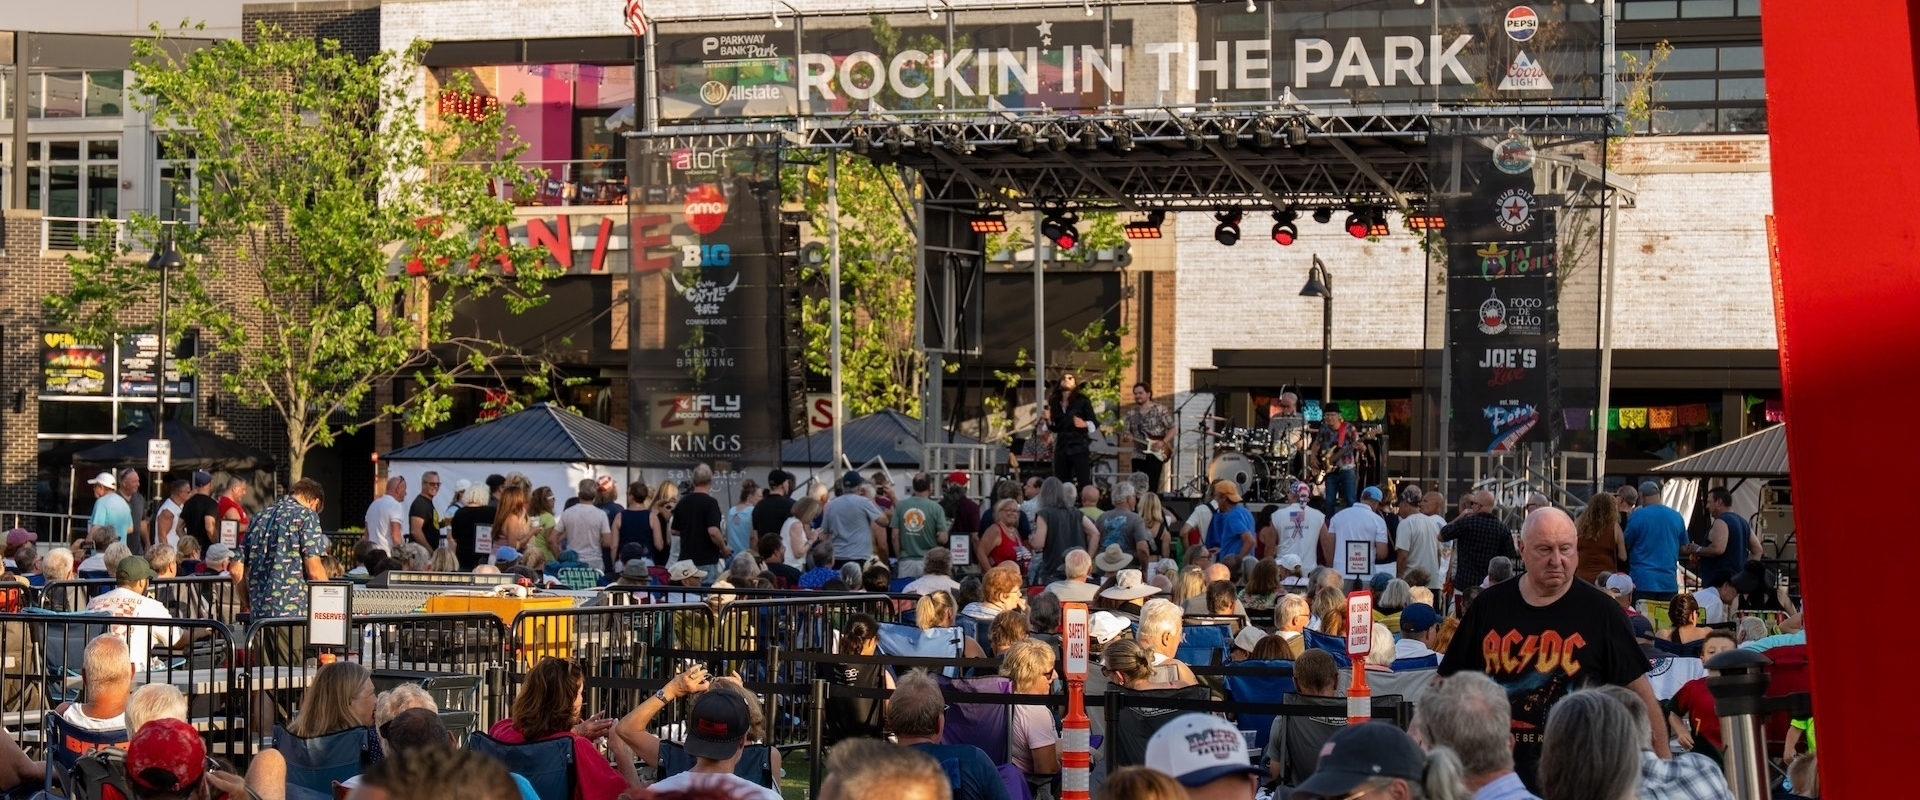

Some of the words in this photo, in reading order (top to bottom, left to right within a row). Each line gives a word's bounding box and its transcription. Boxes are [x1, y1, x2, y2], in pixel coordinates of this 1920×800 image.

[1507, 19, 1537, 28] PEPSI
[720, 34, 766, 45] PARKWAY
[720, 46, 747, 56] BANK
[746, 43, 779, 58] Park
[798, 47, 1038, 101] ROCKIN
[1063, 43, 1123, 94] IN
[1143, 38, 1272, 91] THE
[1295, 34, 1476, 88] PARK
[1507, 63, 1545, 78] Coors
[1511, 79, 1540, 87] LIGHT
[726, 84, 780, 101] Allstate
[676, 146, 728, 170] aloft
[1496, 188, 1515, 207] BUB
[1517, 188, 1536, 206] CITY
[1495, 214, 1514, 232] BUB
[1515, 214, 1535, 232] CITY
[1511, 245, 1532, 262] FAT
[685, 286, 727, 303] CATTLE
[1510, 298, 1542, 308] FOGO
[1518, 307, 1531, 316] DE
[684, 348, 726, 358] CRUST
[1479, 348, 1537, 369] JOE'S
[676, 358, 734, 368] BREWING
[667, 469, 747, 479] salater
[1351, 604, 1357, 613] NO
[1357, 602, 1369, 613] CHAIRS
[314, 612, 347, 620] RESERVED
[1357, 614, 1363, 623] OR
[1069, 622, 1085, 639] SAFETY
[1351, 625, 1368, 635] STANDING
[1070, 642, 1084, 659] AISLE
[1694, 717, 1702, 736] 7
[1522, 733, 1535, 743] BE
